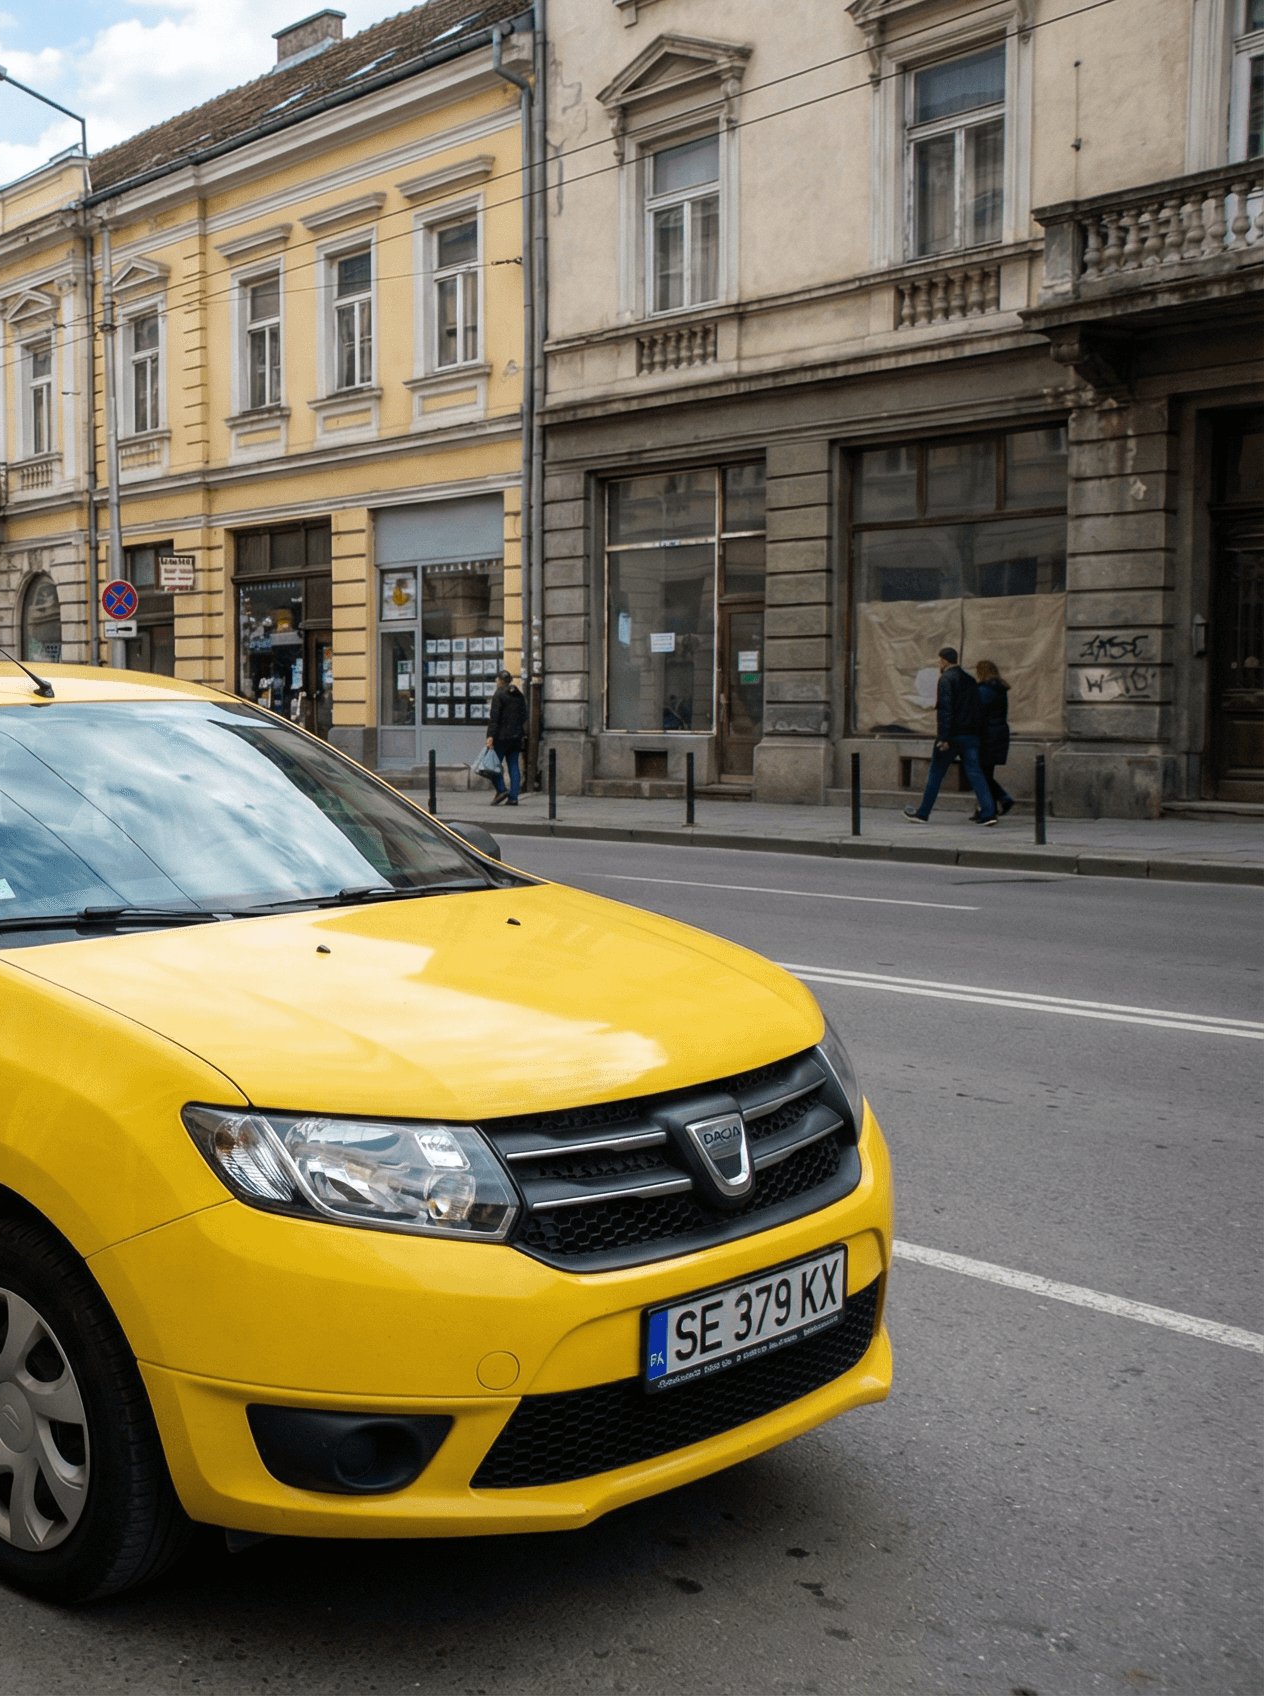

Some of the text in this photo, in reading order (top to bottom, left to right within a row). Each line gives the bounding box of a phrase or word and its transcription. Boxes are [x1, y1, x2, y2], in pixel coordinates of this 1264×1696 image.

[675, 1299, 724, 1361] SE
[734, 1278, 791, 1341] 379
[800, 1258, 840, 1319] KX
